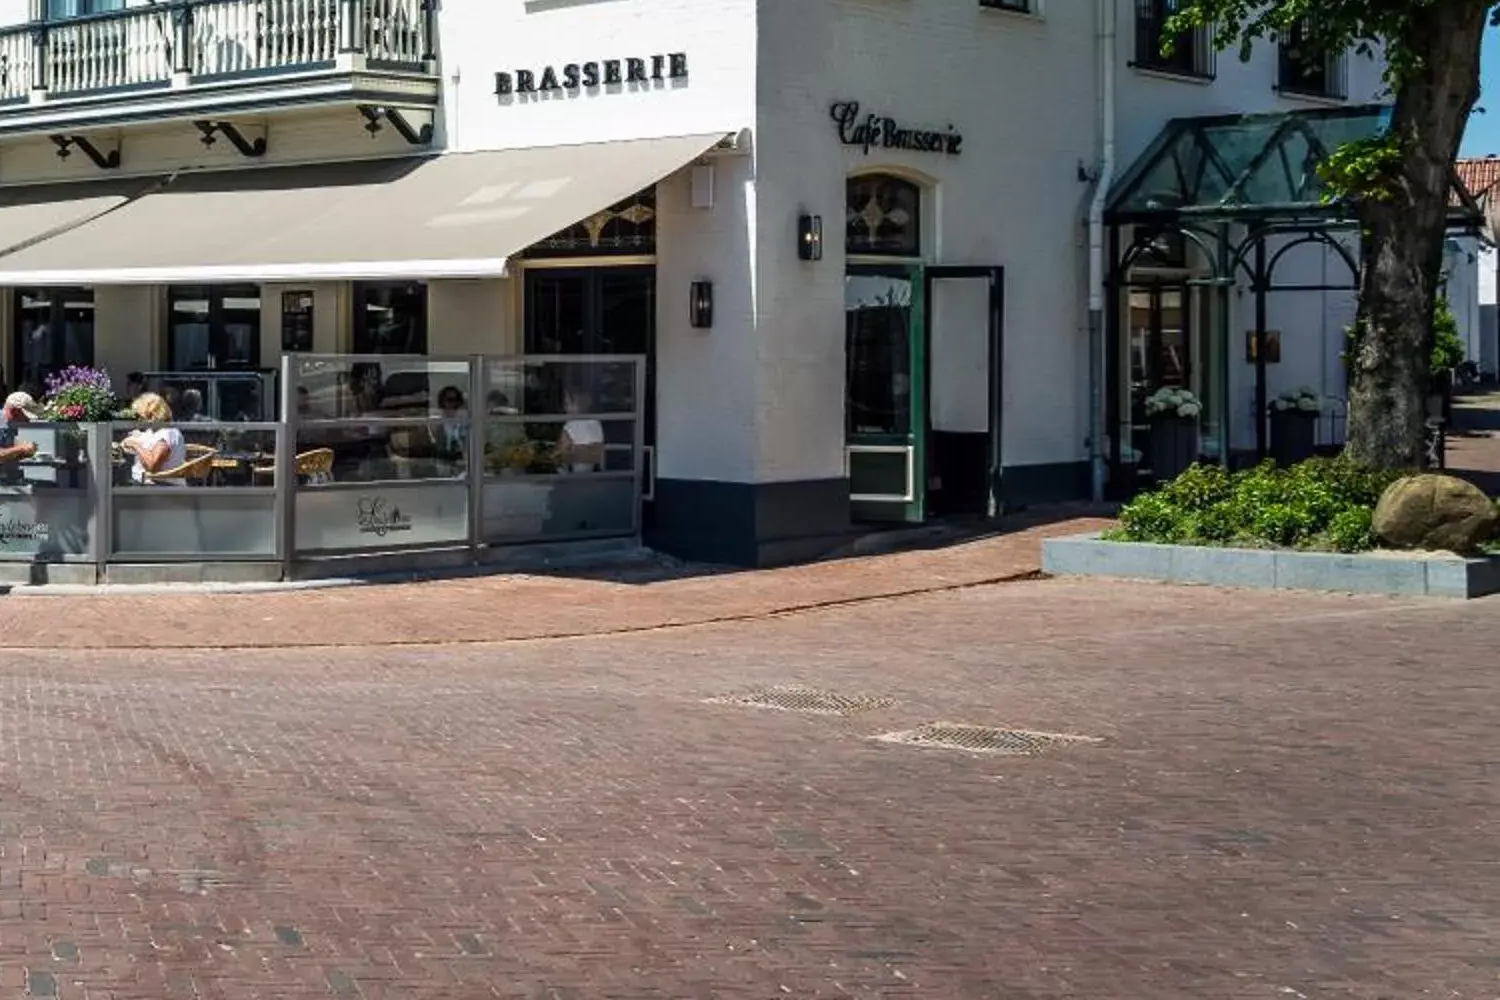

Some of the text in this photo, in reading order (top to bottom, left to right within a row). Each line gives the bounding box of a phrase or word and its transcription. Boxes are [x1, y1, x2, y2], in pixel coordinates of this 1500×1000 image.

[494, 52, 688, 94] BRASSERIE
[830, 101, 963, 155] Café Brasserie
